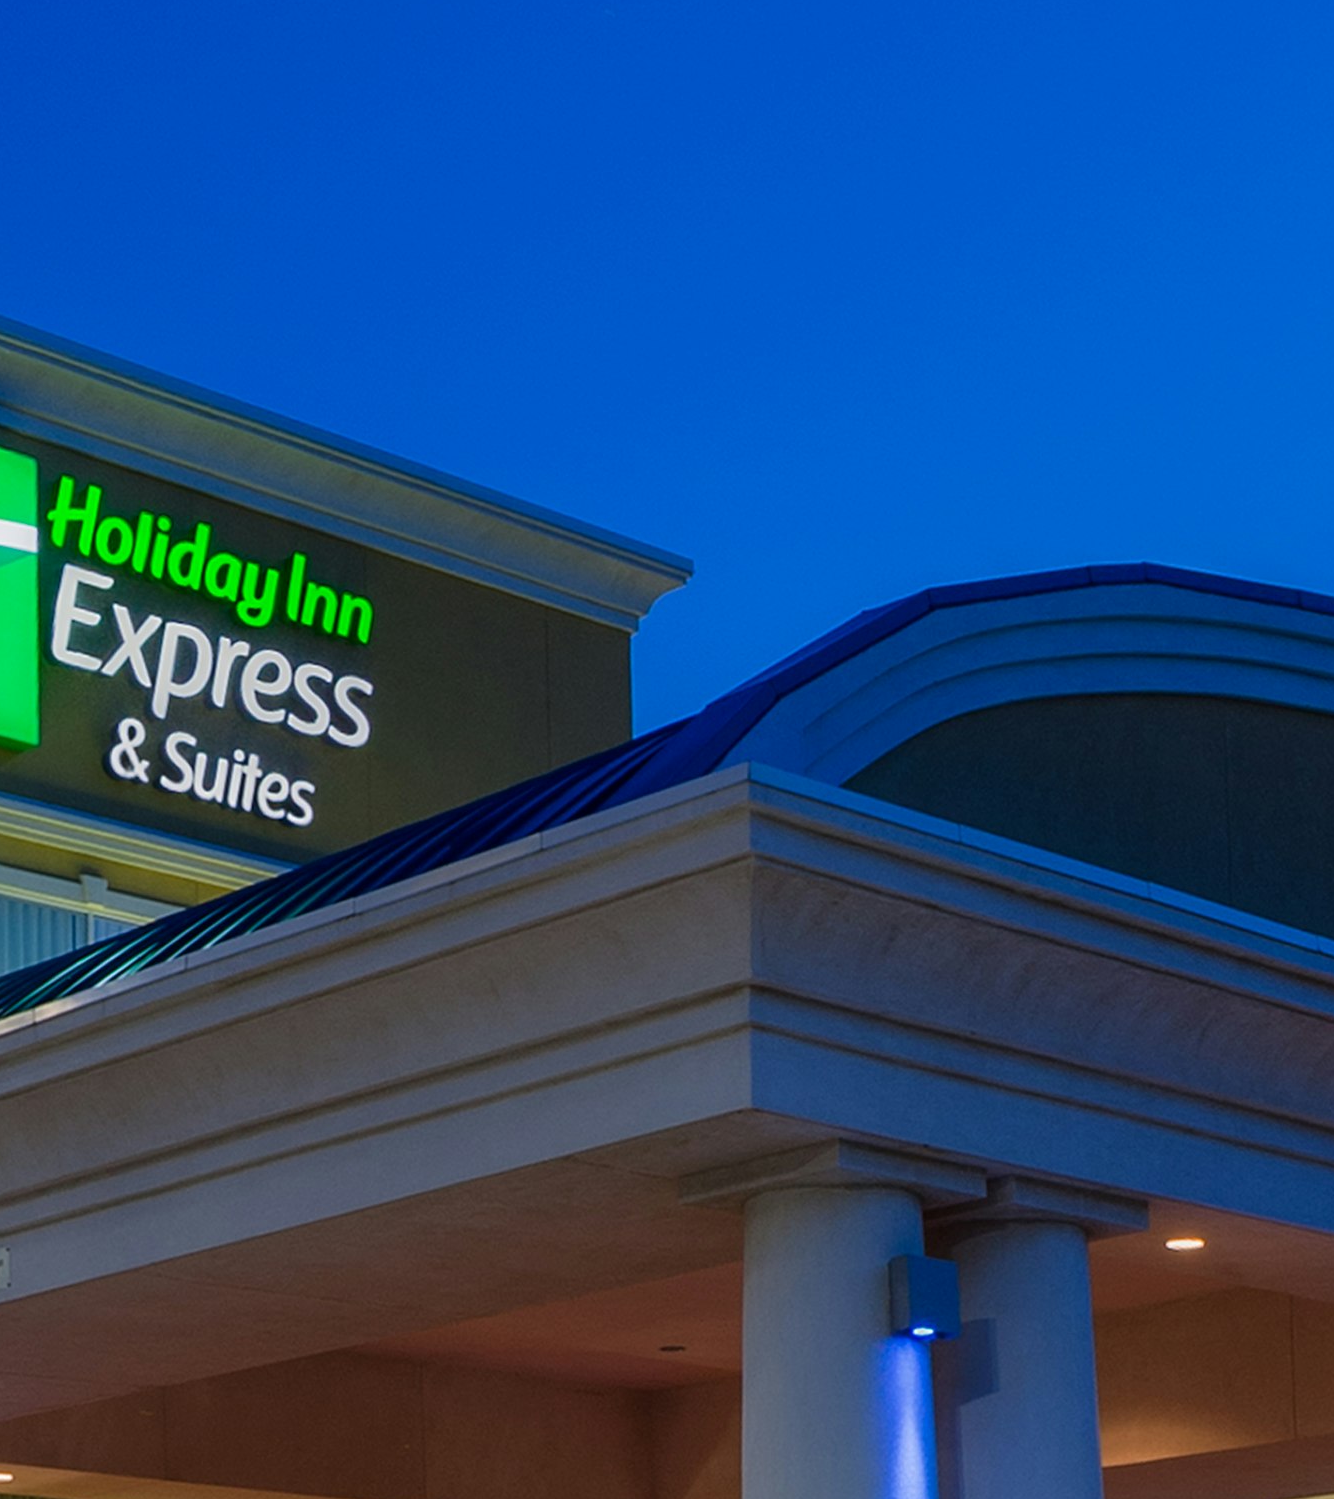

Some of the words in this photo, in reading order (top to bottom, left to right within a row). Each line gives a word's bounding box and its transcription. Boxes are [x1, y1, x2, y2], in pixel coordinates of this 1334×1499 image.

[47, 476, 278, 628] Holiday
[287, 553, 373, 644] Inn
[52, 564, 373, 748] Express
[109, 717, 149, 784] &
[161, 732, 315, 826] Suites
